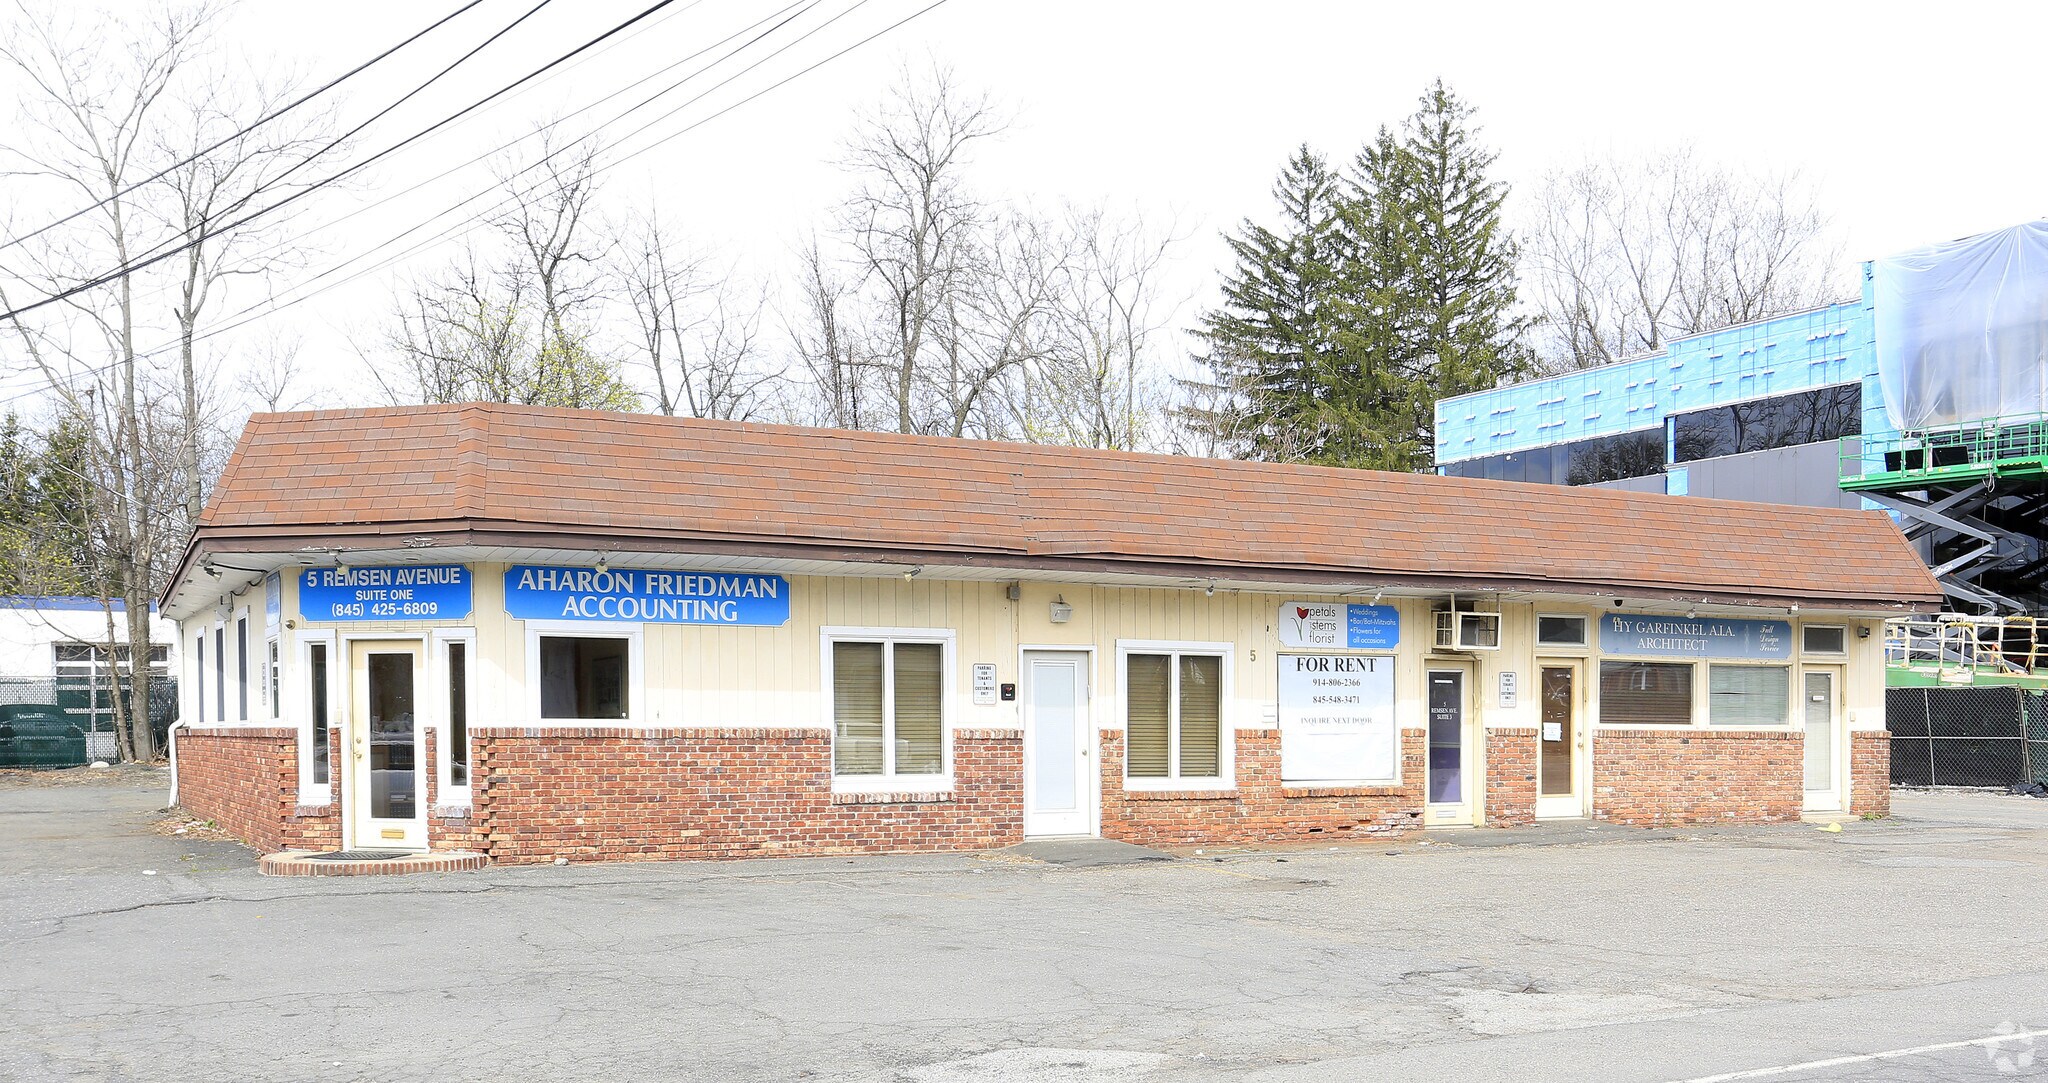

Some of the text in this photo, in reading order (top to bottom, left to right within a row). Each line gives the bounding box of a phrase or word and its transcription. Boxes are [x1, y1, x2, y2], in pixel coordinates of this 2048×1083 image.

[307, 567, 461, 587] 5 REMSEN AVENUE
[517, 569, 777, 599] AHARON FRIEDMAN
[355, 589, 413, 601] SUITE ONE
[331, 602, 438, 617] (845) 425-6809
[561, 595, 738, 622] ACCOUNTING
[1309, 605, 1336, 619] petals
[1353, 608, 1378, 617] Weddings
[1312, 620, 1336, 630] stems
[1353, 617, 1396, 626] Bar/Bat-Mitzvahs
[1613, 620, 1736, 637] HY GARFINKEL A.I.A.
[1760, 624, 1774, 634] Full
[1309, 630, 1335, 644] florist
[1760, 634, 1778, 645] Design
[1637, 638, 1708, 651] ARCHITECT
[1760, 643, 1779, 652] Service
[1250, 650, 1256, 662] 5
[1296, 657, 1377, 672] FOR RENT
[1312, 678, 1360, 687] 914-806-2366
[1301, 717, 1330, 726] INQUIRE
